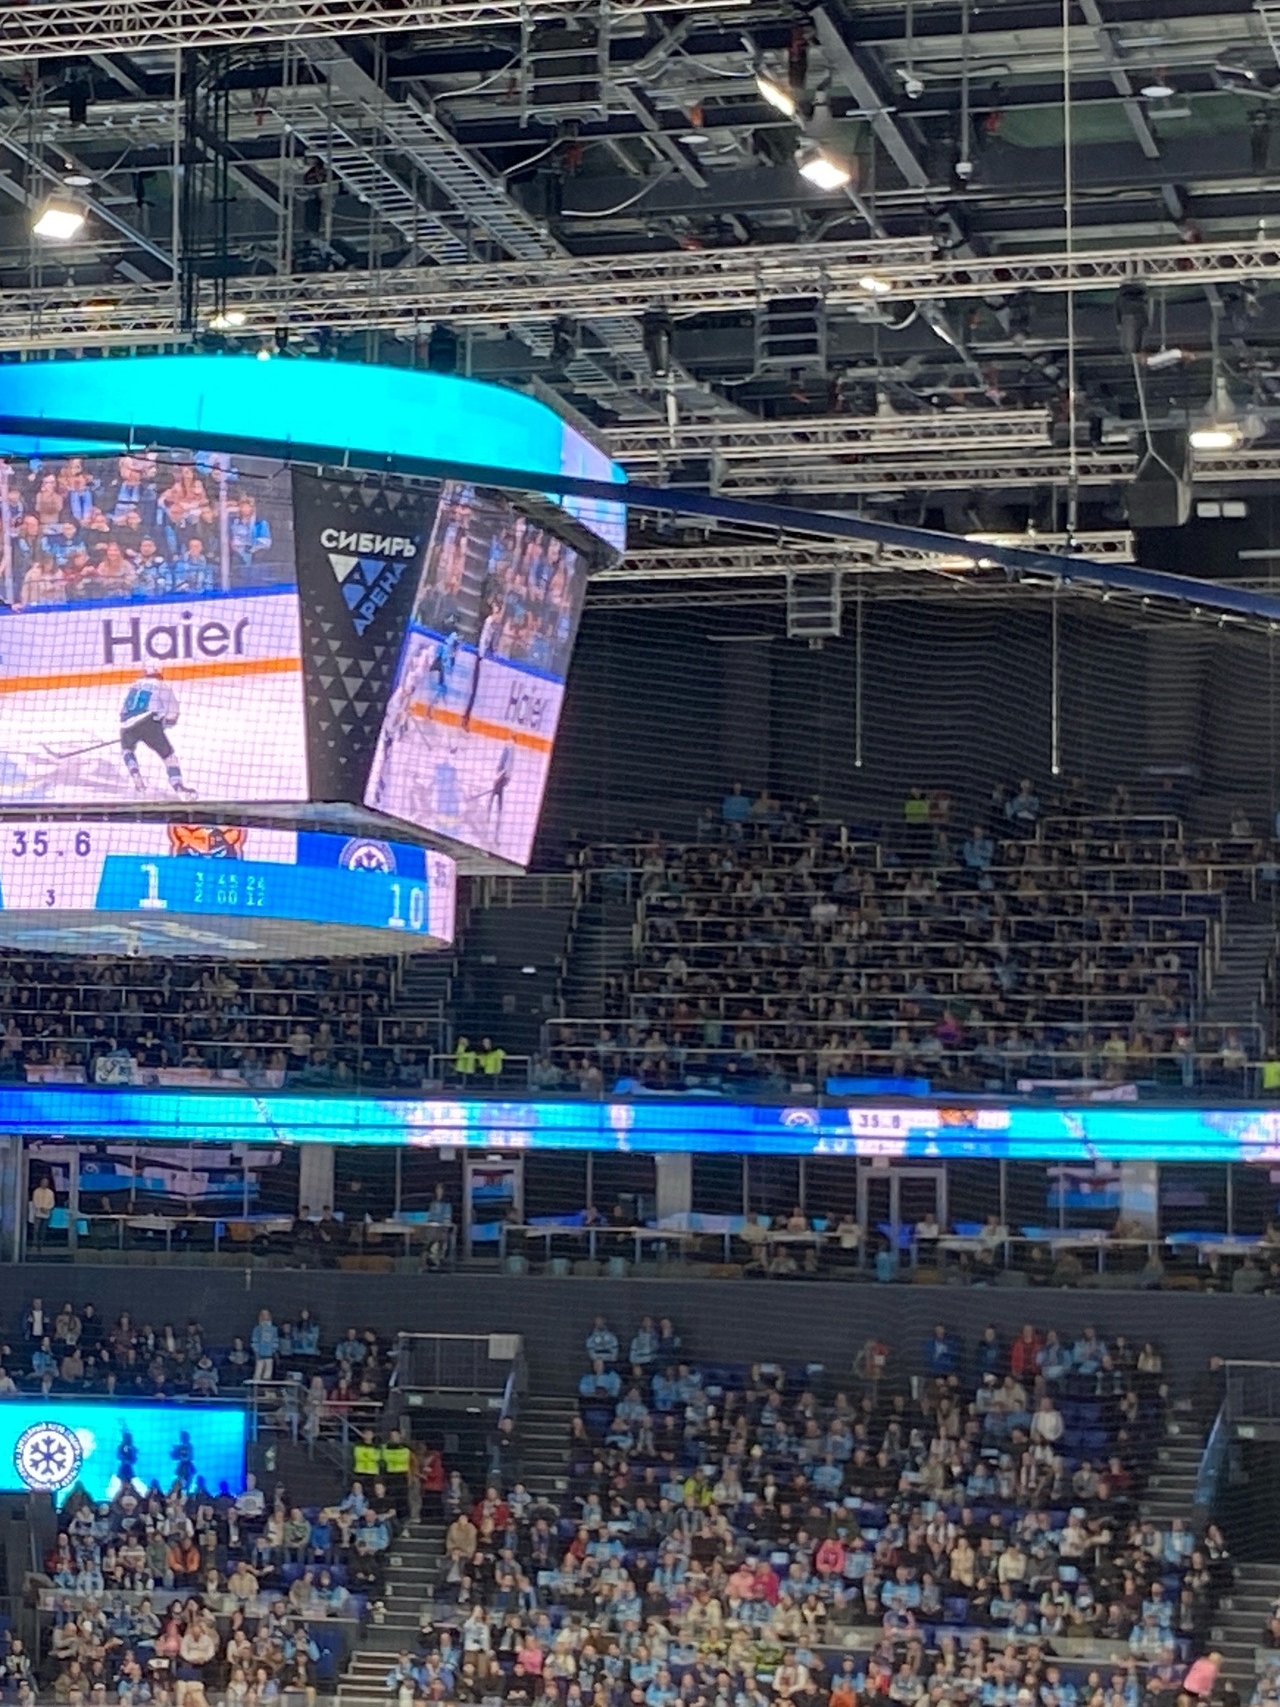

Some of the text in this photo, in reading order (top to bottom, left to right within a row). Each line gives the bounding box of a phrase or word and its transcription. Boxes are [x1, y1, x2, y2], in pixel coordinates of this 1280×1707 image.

[320, 528, 417, 558] СИБИРЬ
[352, 562, 408, 637] АРЕНА
[102, 610, 249, 664] Haier
[11, 830, 91, 857] 35.6
[45, 890, 56, 907] 3
[139, 863, 168, 909] 1
[387, 882, 424, 930] 10
